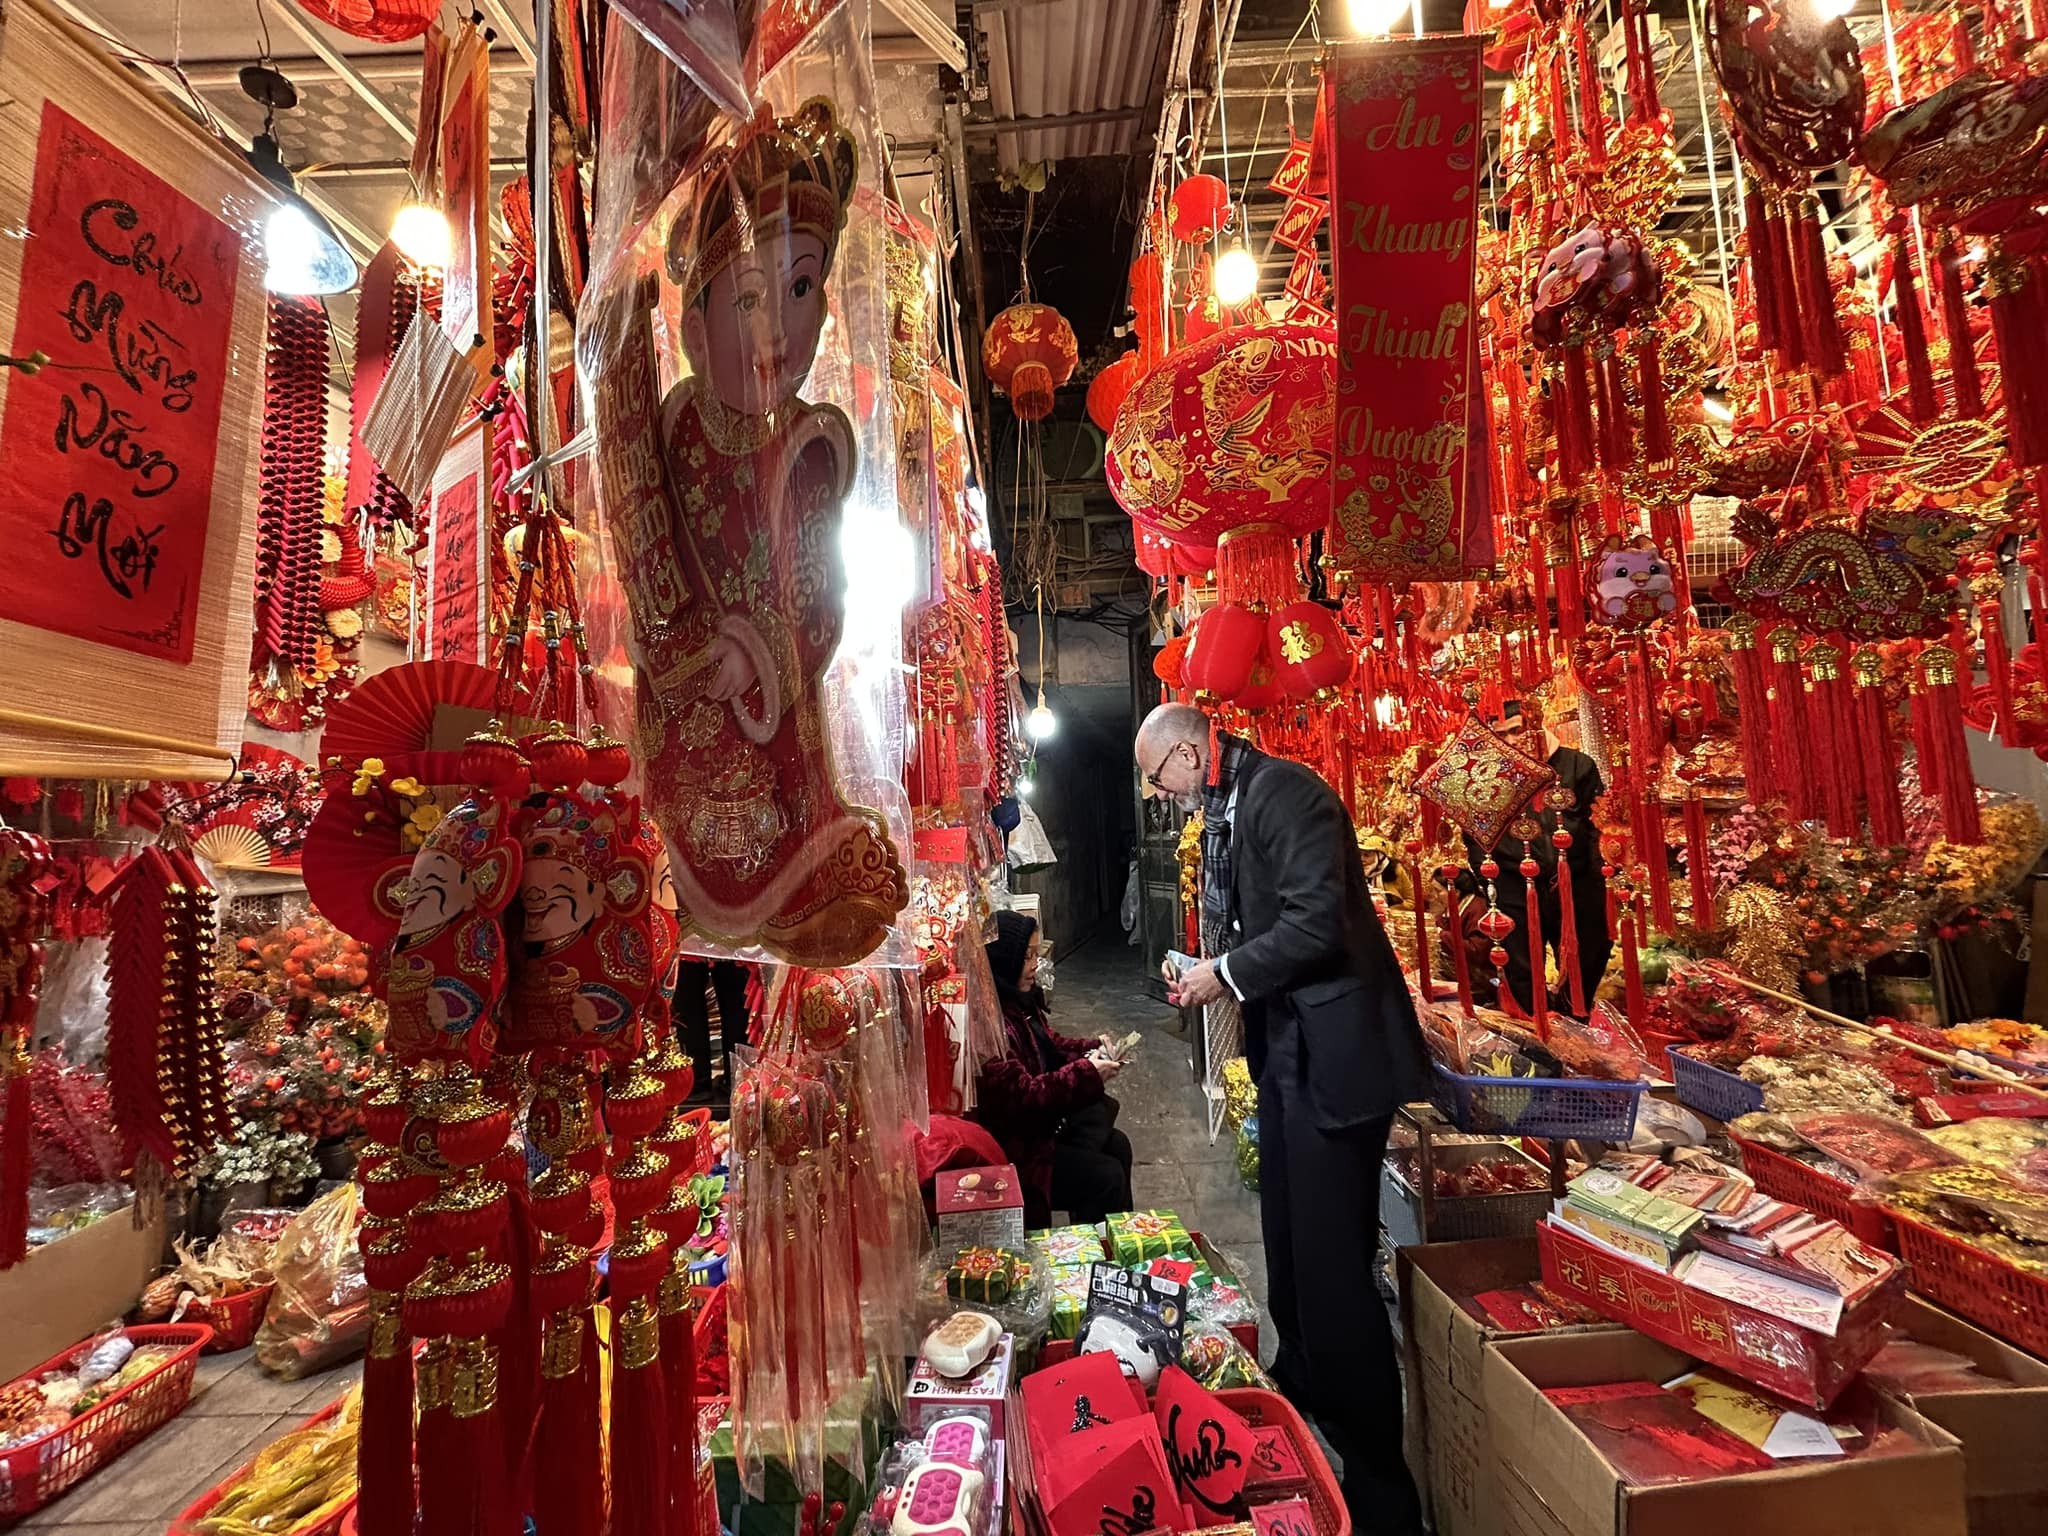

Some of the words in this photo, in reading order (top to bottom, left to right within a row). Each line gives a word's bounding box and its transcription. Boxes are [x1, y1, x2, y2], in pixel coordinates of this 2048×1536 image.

[1366, 97, 1442, 151] An
[80, 199, 202, 305] Chúc
[1343, 201, 1469, 262] Khang
[58, 279, 197, 412] Mừng
[1347, 303, 1458, 368] Thịnh
[55, 382, 178, 498] Năm
[1154, 497, 1211, 531] Mới
[46, 492, 164, 599] Mới
[717, 815, 744, 851] 福
[931, 1385, 961, 1395] PUSH
[967, 1386, 995, 1396] FAST
